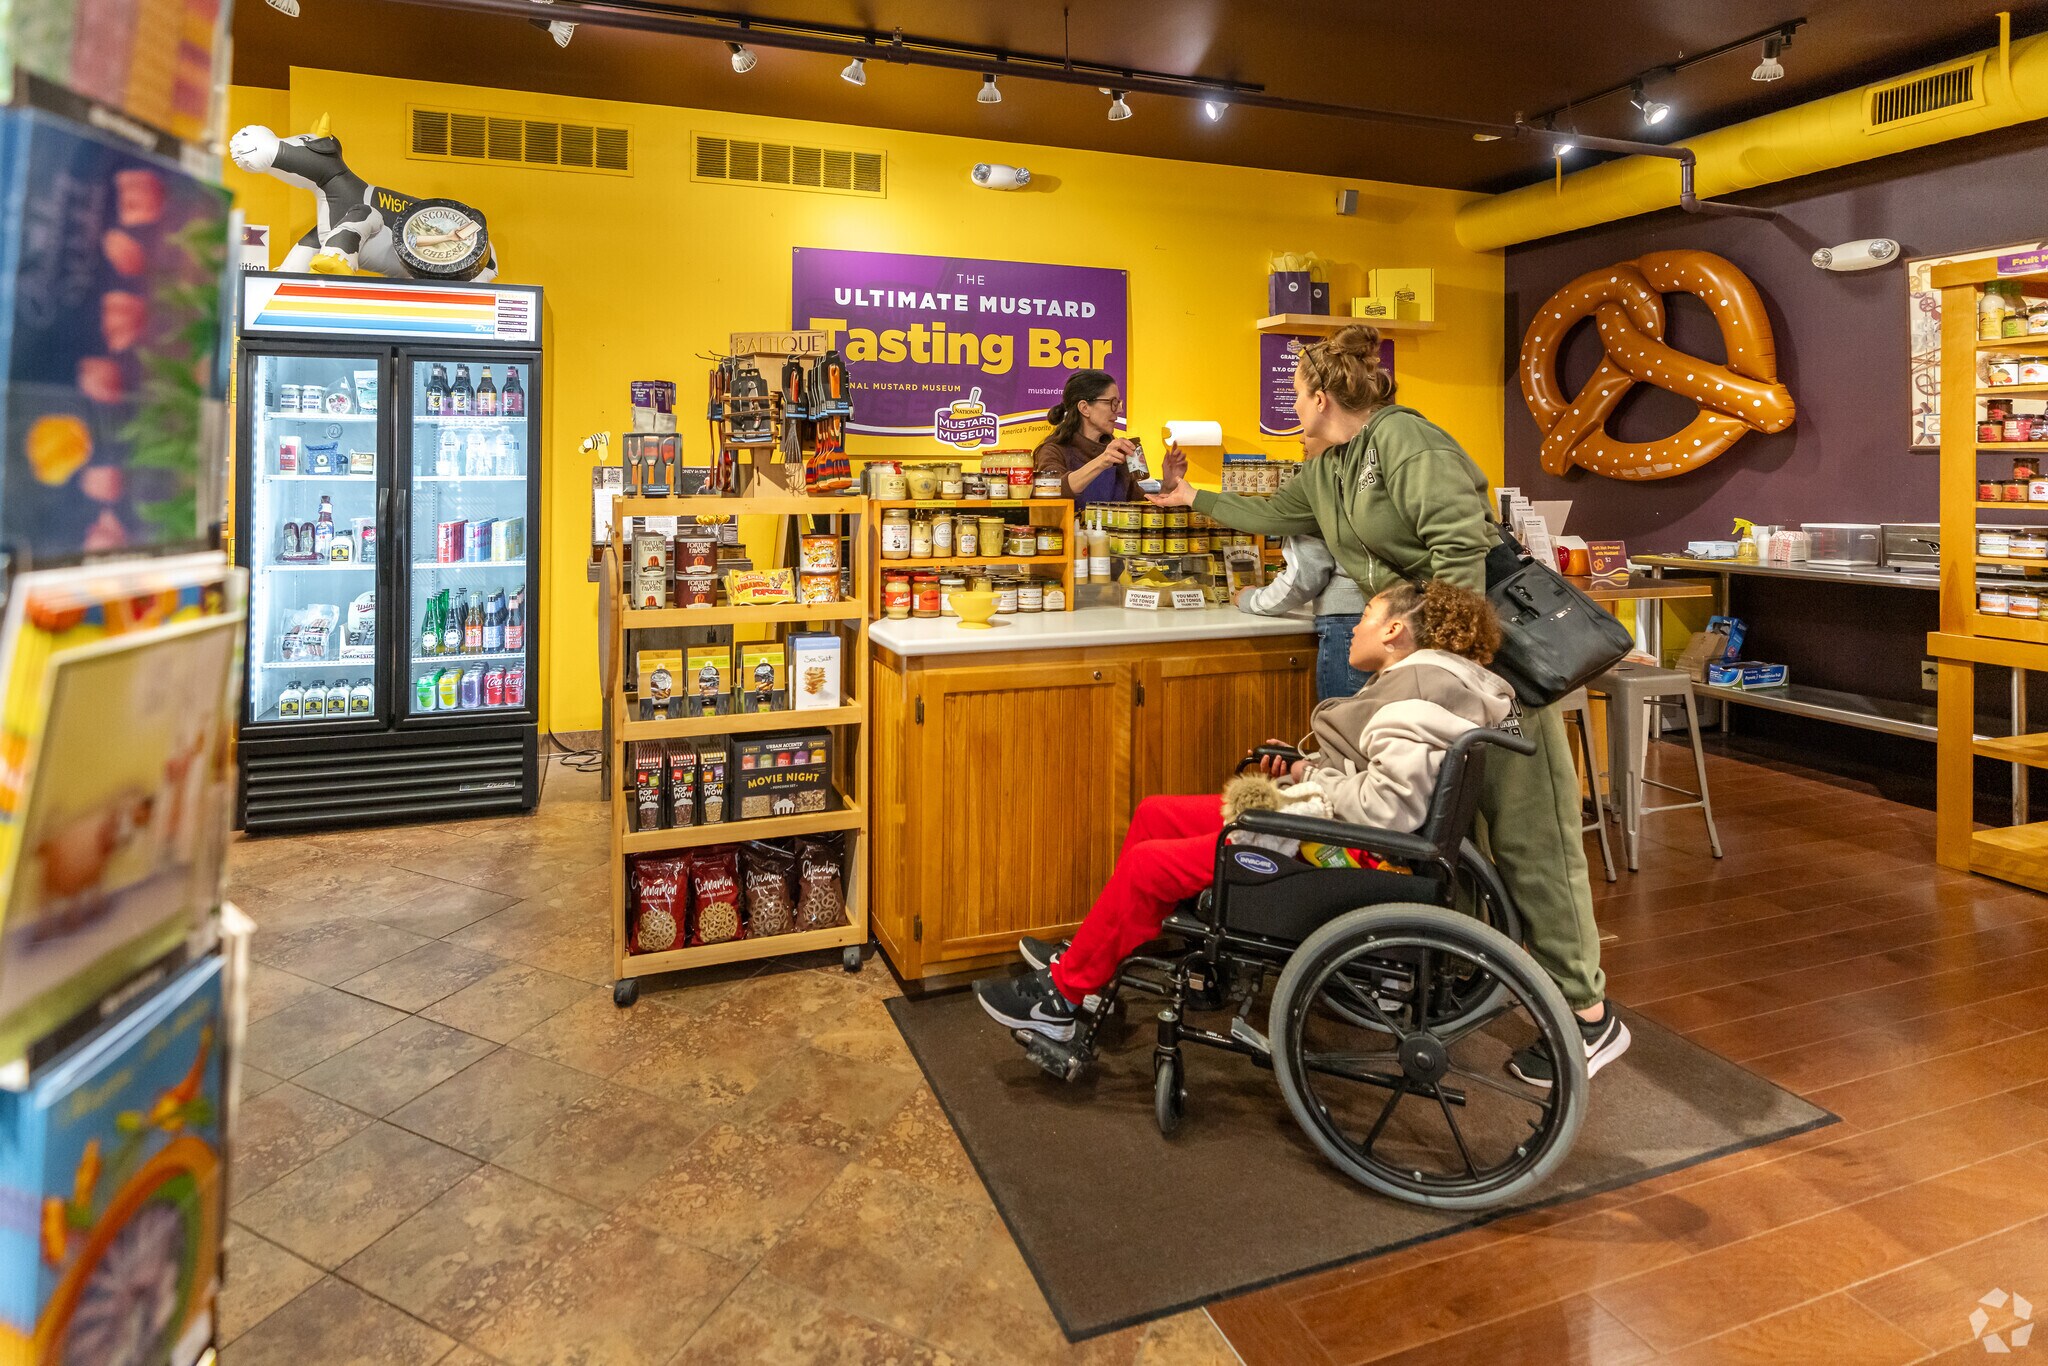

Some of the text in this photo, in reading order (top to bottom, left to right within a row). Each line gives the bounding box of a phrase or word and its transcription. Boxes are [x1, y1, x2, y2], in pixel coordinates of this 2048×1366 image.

[378, 191, 413, 213] WISC
[411, 210, 466, 231] WISCONSIN
[423, 243, 464, 259] CHEESE
[2012, 255, 2039, 266] Fruit
[957, 273, 985, 286] THE
[834, 287, 1096, 319] ULTIMATE MUSTARD
[736, 335, 820, 353] BALTIQUE
[809, 317, 1113, 375] Tasting Bar
[873, 382, 918, 391] MUSTARD
[922, 384, 961, 392] MUSEUM
[1027, 387, 1064, 395] mustardm
[939, 416, 995, 429] MUSTARD
[939, 428, 995, 441] MUSEUM
[1001, 424, 1052, 436] America's Favorite
[1242, 550, 1258, 558] SELLER
[747, 772, 820, 789] MOVIE NIGHT
[674, 791, 693, 799] WOW
[1240, 857, 1271, 868] INVACARE
[695, 876, 734, 895] Cinnamon
